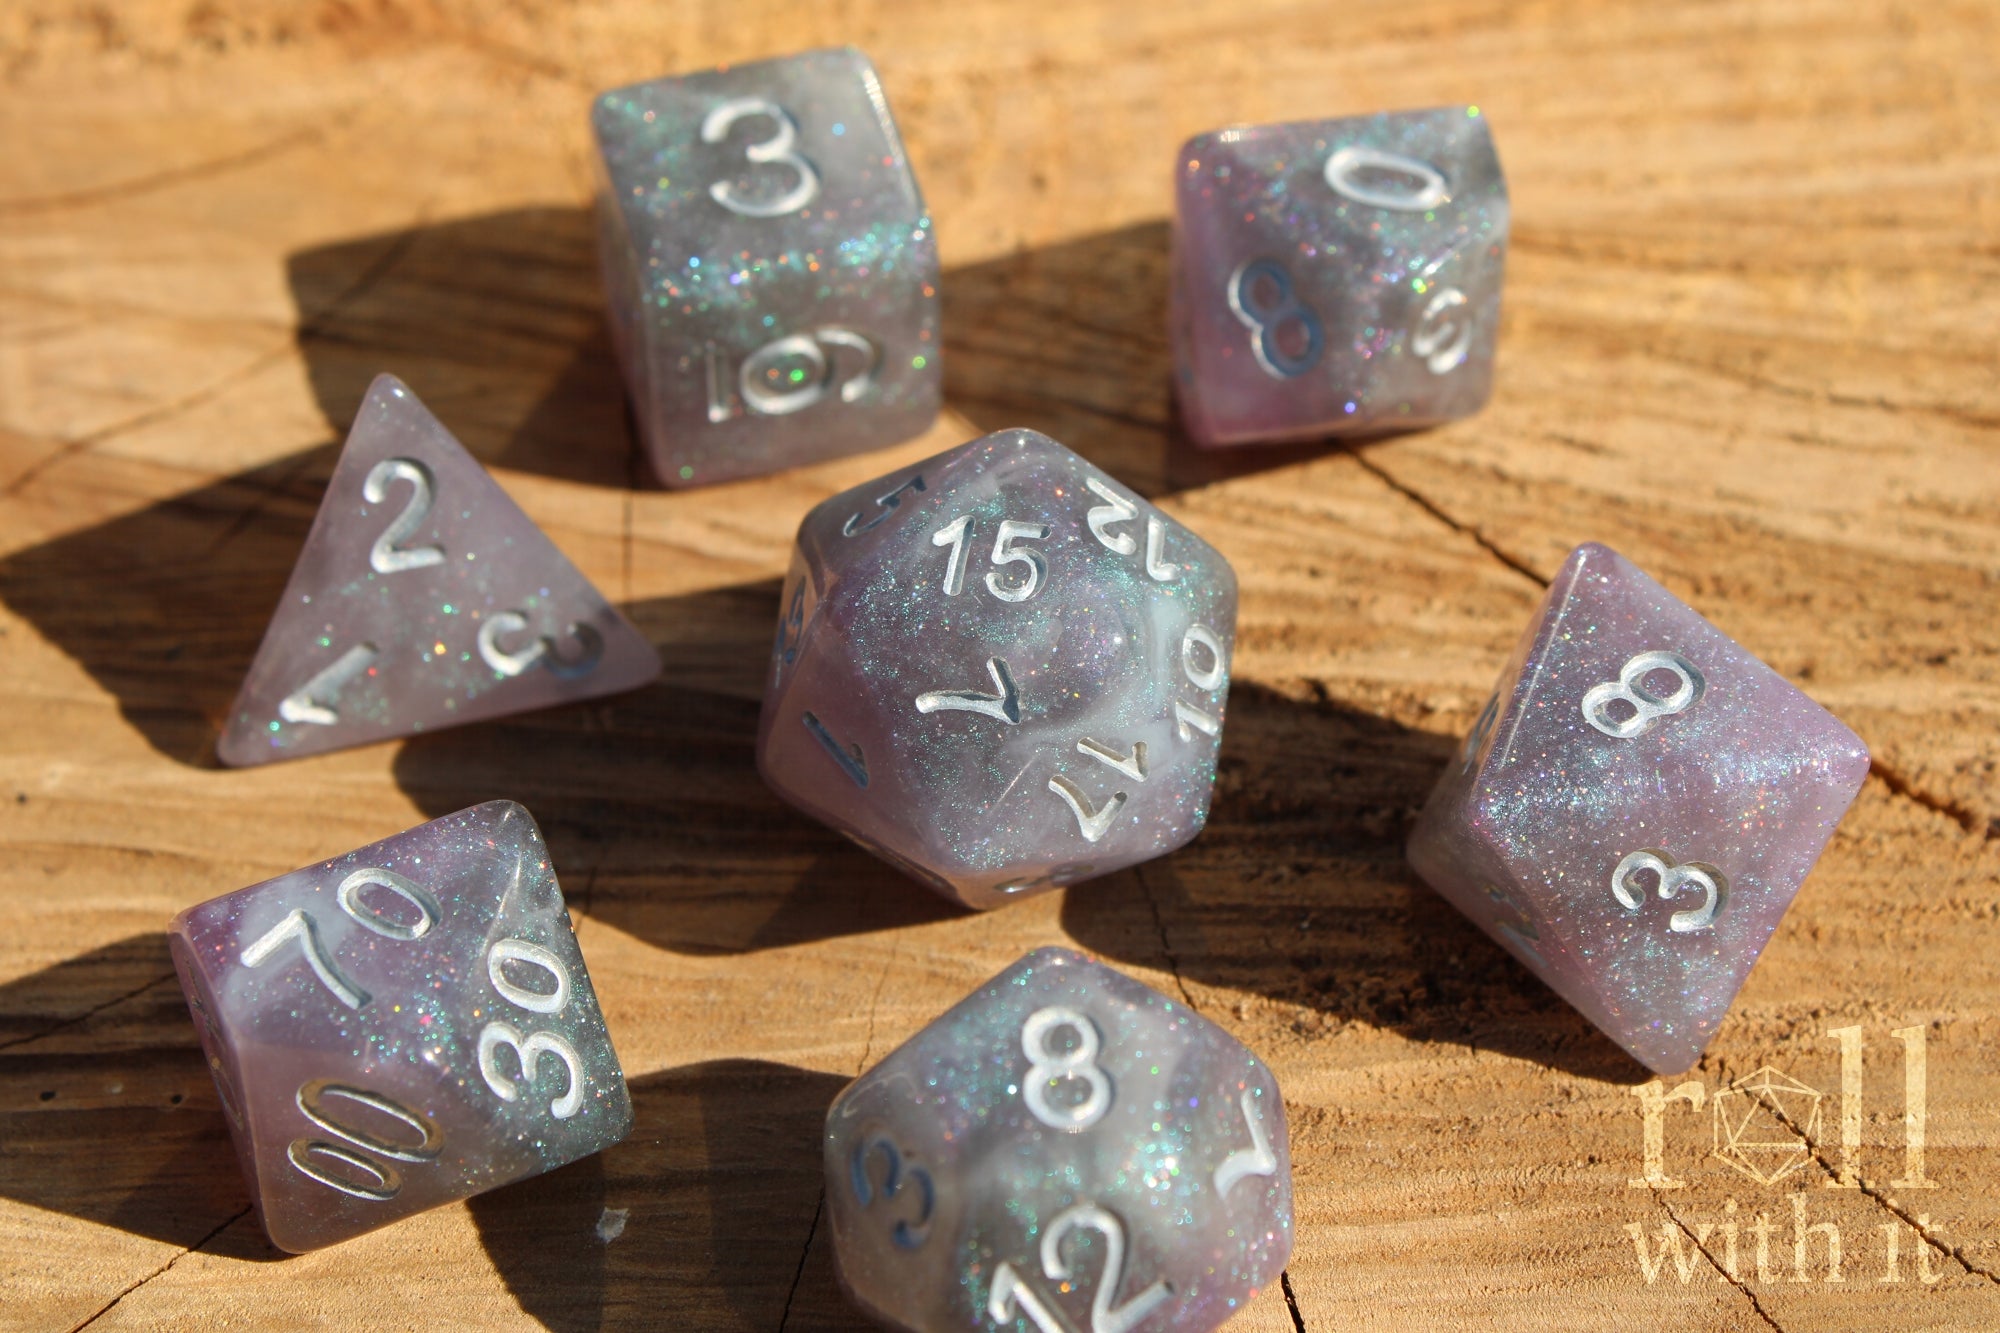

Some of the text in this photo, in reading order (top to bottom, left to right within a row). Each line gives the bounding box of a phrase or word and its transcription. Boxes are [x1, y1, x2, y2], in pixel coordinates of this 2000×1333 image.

[702, 97, 819, 217] 3
[1324, 147, 1448, 211] 0
[1227, 259, 1323, 380] 8
[704, 323, 882, 423] 6
[363, 456, 446, 574] 2
[931, 514, 1053, 602] 15
[279, 640, 378, 726] 1
[477, 609, 605, 680] 3
[915, 656, 1023, 726] 7
[1173, 623, 1227, 744] 10
[1581, 650, 1706, 739] 8
[1047, 737, 1149, 843] 17
[240, 866, 444, 1011] 70
[1611, 847, 1731, 933] 3
[477, 937, 586, 1121] 30
[1021, 1005, 1113, 1131] 8
[850, 1132, 935, 1251] 3
